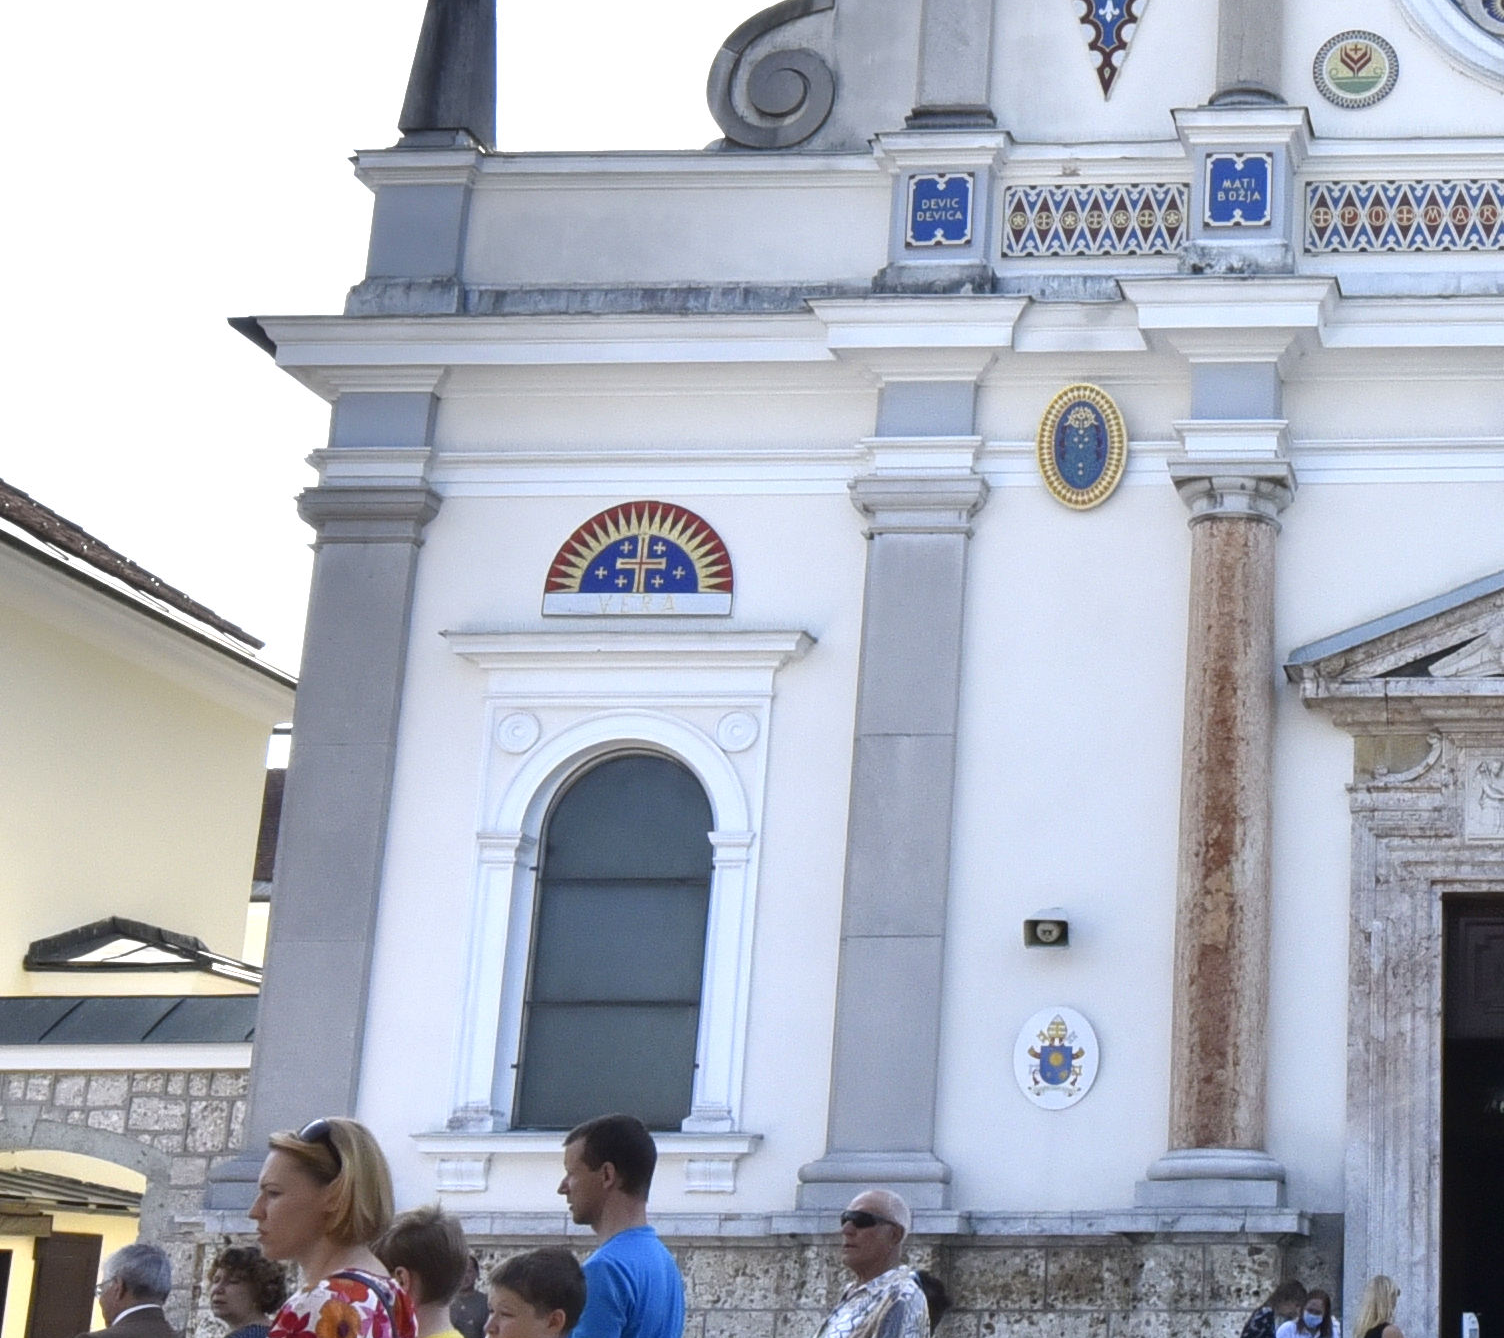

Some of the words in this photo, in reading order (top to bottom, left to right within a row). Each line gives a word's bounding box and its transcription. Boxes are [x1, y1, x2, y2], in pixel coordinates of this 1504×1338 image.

[1222, 177, 1256, 189] MATI
[1217, 189, 1261, 203] BOŽJA
[921, 197, 960, 210] DEVIC
[916, 210, 964, 222] DEVICA
